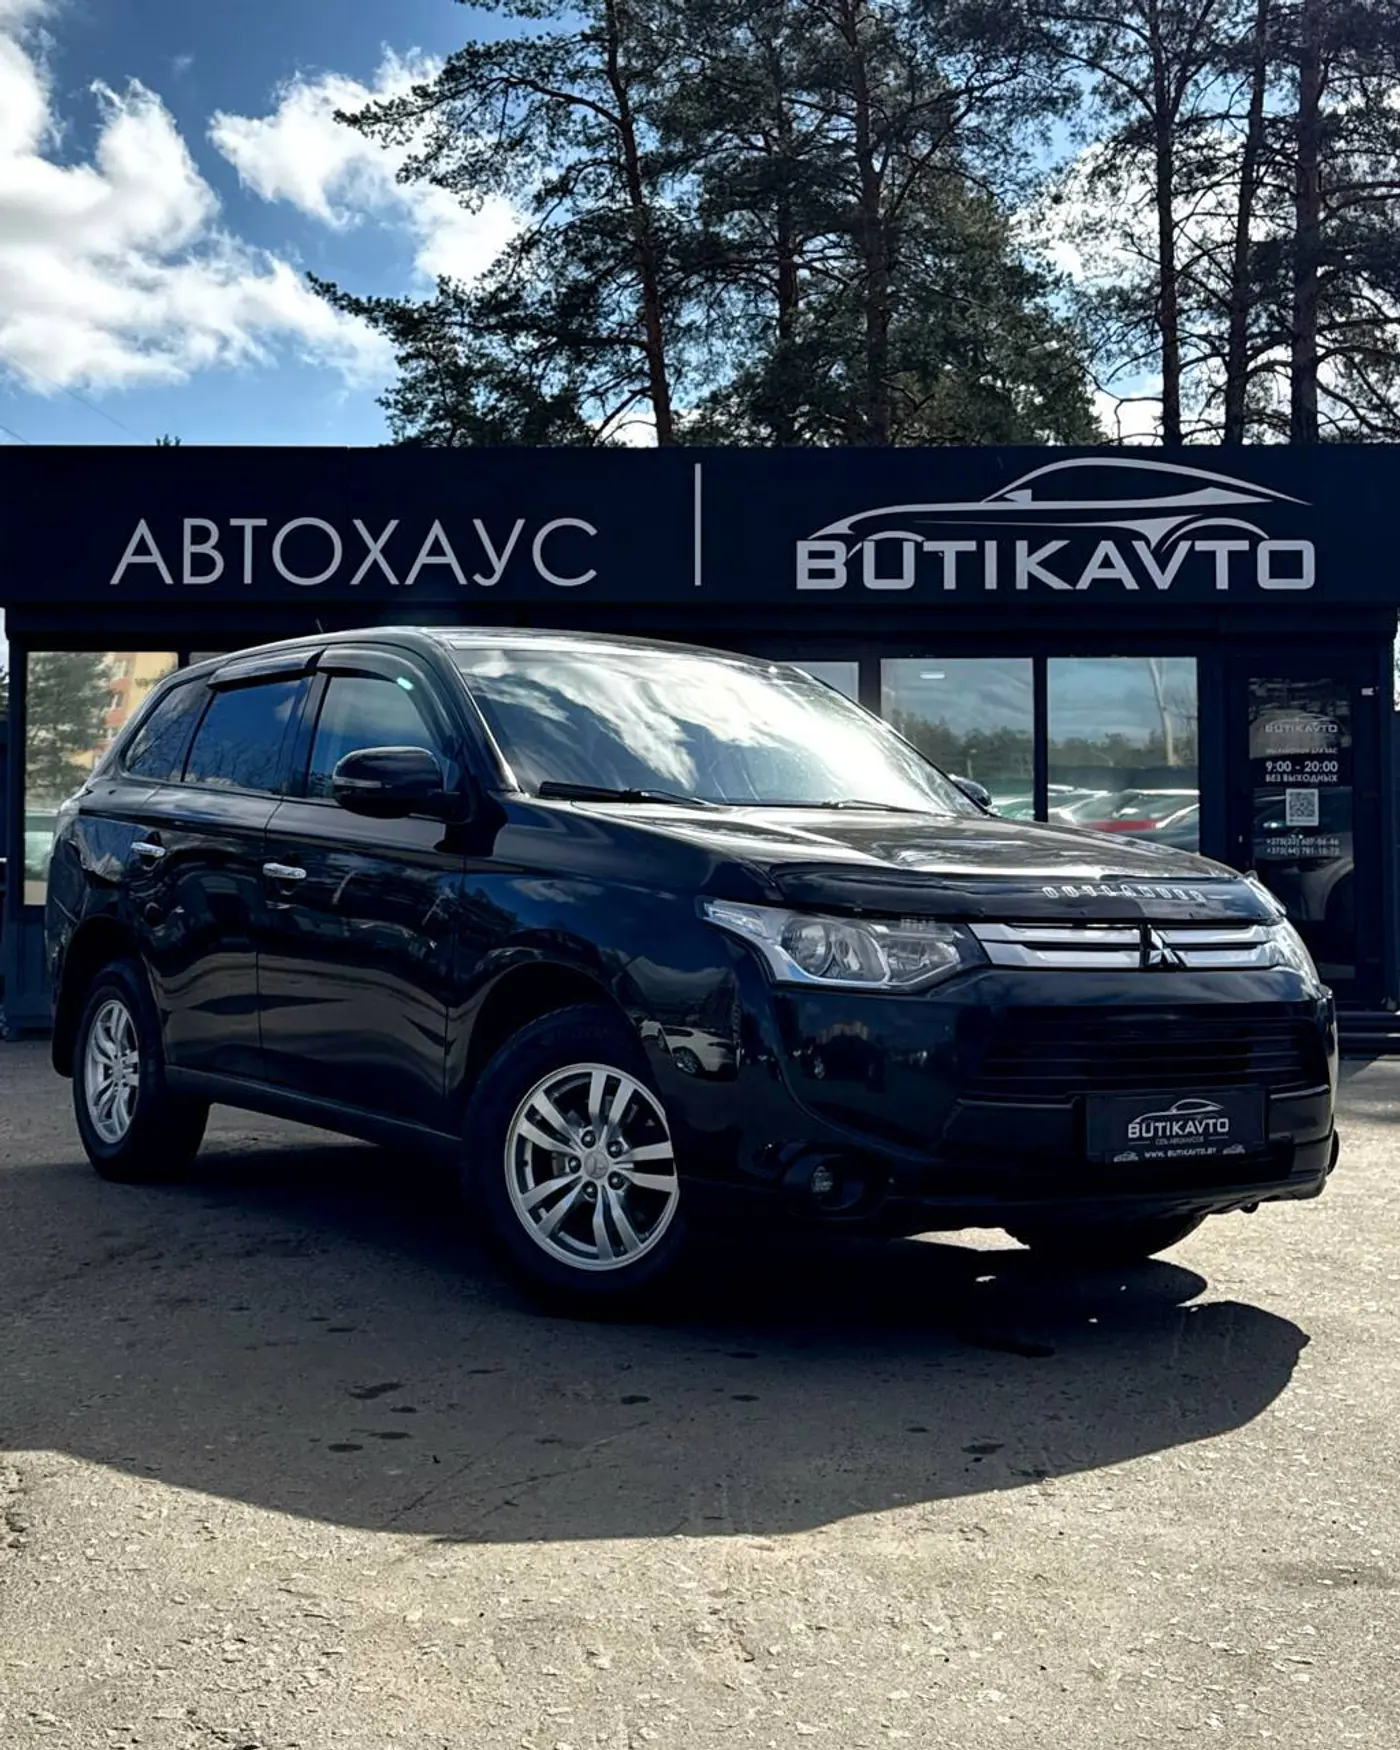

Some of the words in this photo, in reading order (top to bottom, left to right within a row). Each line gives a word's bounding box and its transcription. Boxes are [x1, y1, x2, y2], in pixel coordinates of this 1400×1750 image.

[110, 517, 598, 588] АВТОХАУС
[796, 539, 1316, 591] BUTIKAVTO
[1265, 760, 1292, 773] 9:00
[1304, 760, 1339, 773] 20:00
[1283, 773, 1338, 783] ВЫХОДНЫХ
[1128, 1117, 1229, 1139] BUTIKAVTO
